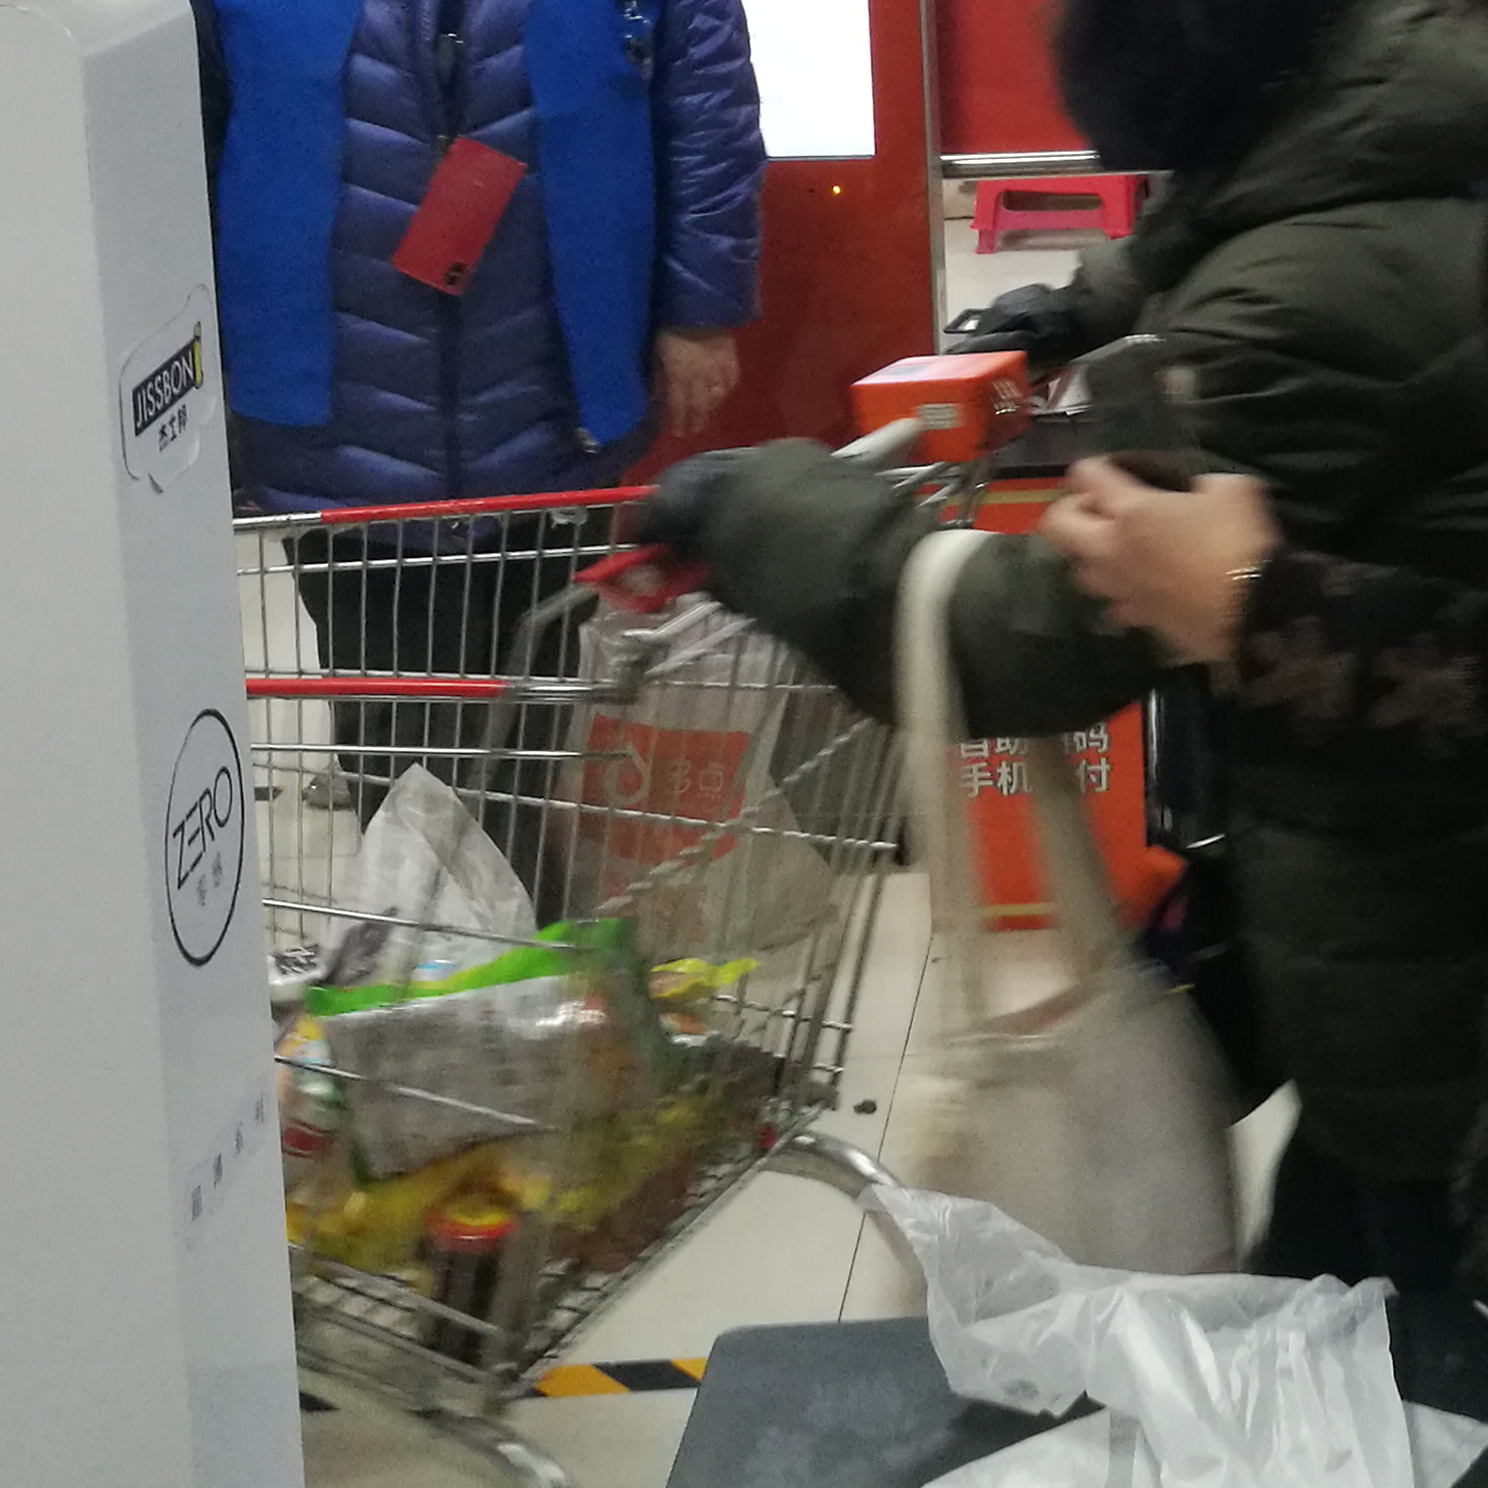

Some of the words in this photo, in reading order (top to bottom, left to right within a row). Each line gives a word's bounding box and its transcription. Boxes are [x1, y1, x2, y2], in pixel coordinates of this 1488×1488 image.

[136, 350, 195, 429] JISSBON
[959, 756, 1112, 798] 手机付
[172, 766, 234, 891] ZERO
